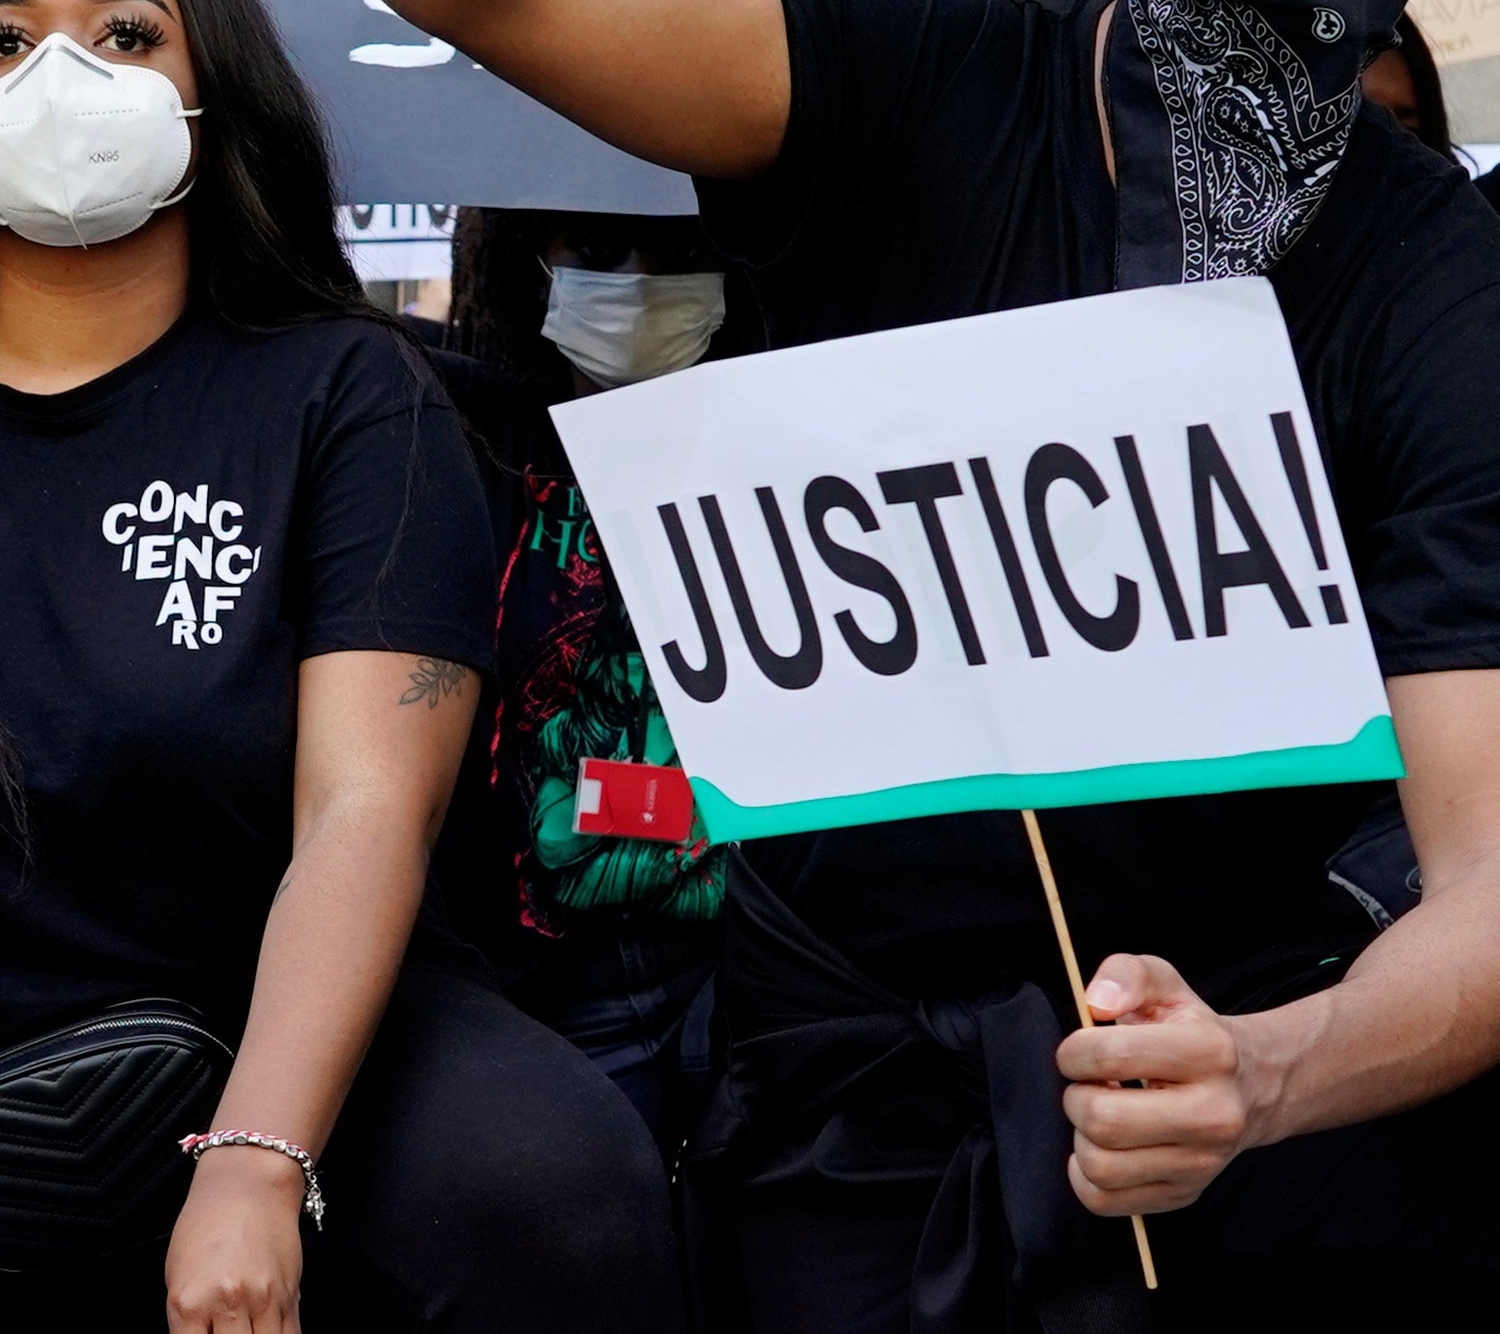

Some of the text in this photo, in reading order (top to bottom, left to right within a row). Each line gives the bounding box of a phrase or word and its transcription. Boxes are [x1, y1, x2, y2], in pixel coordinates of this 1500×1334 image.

[88, 150, 120, 164] KN95
[101, 479, 245, 546] CONC
[120, 533, 263, 585] IENCI
[656, 410, 1350, 704] JUSTICIA!
